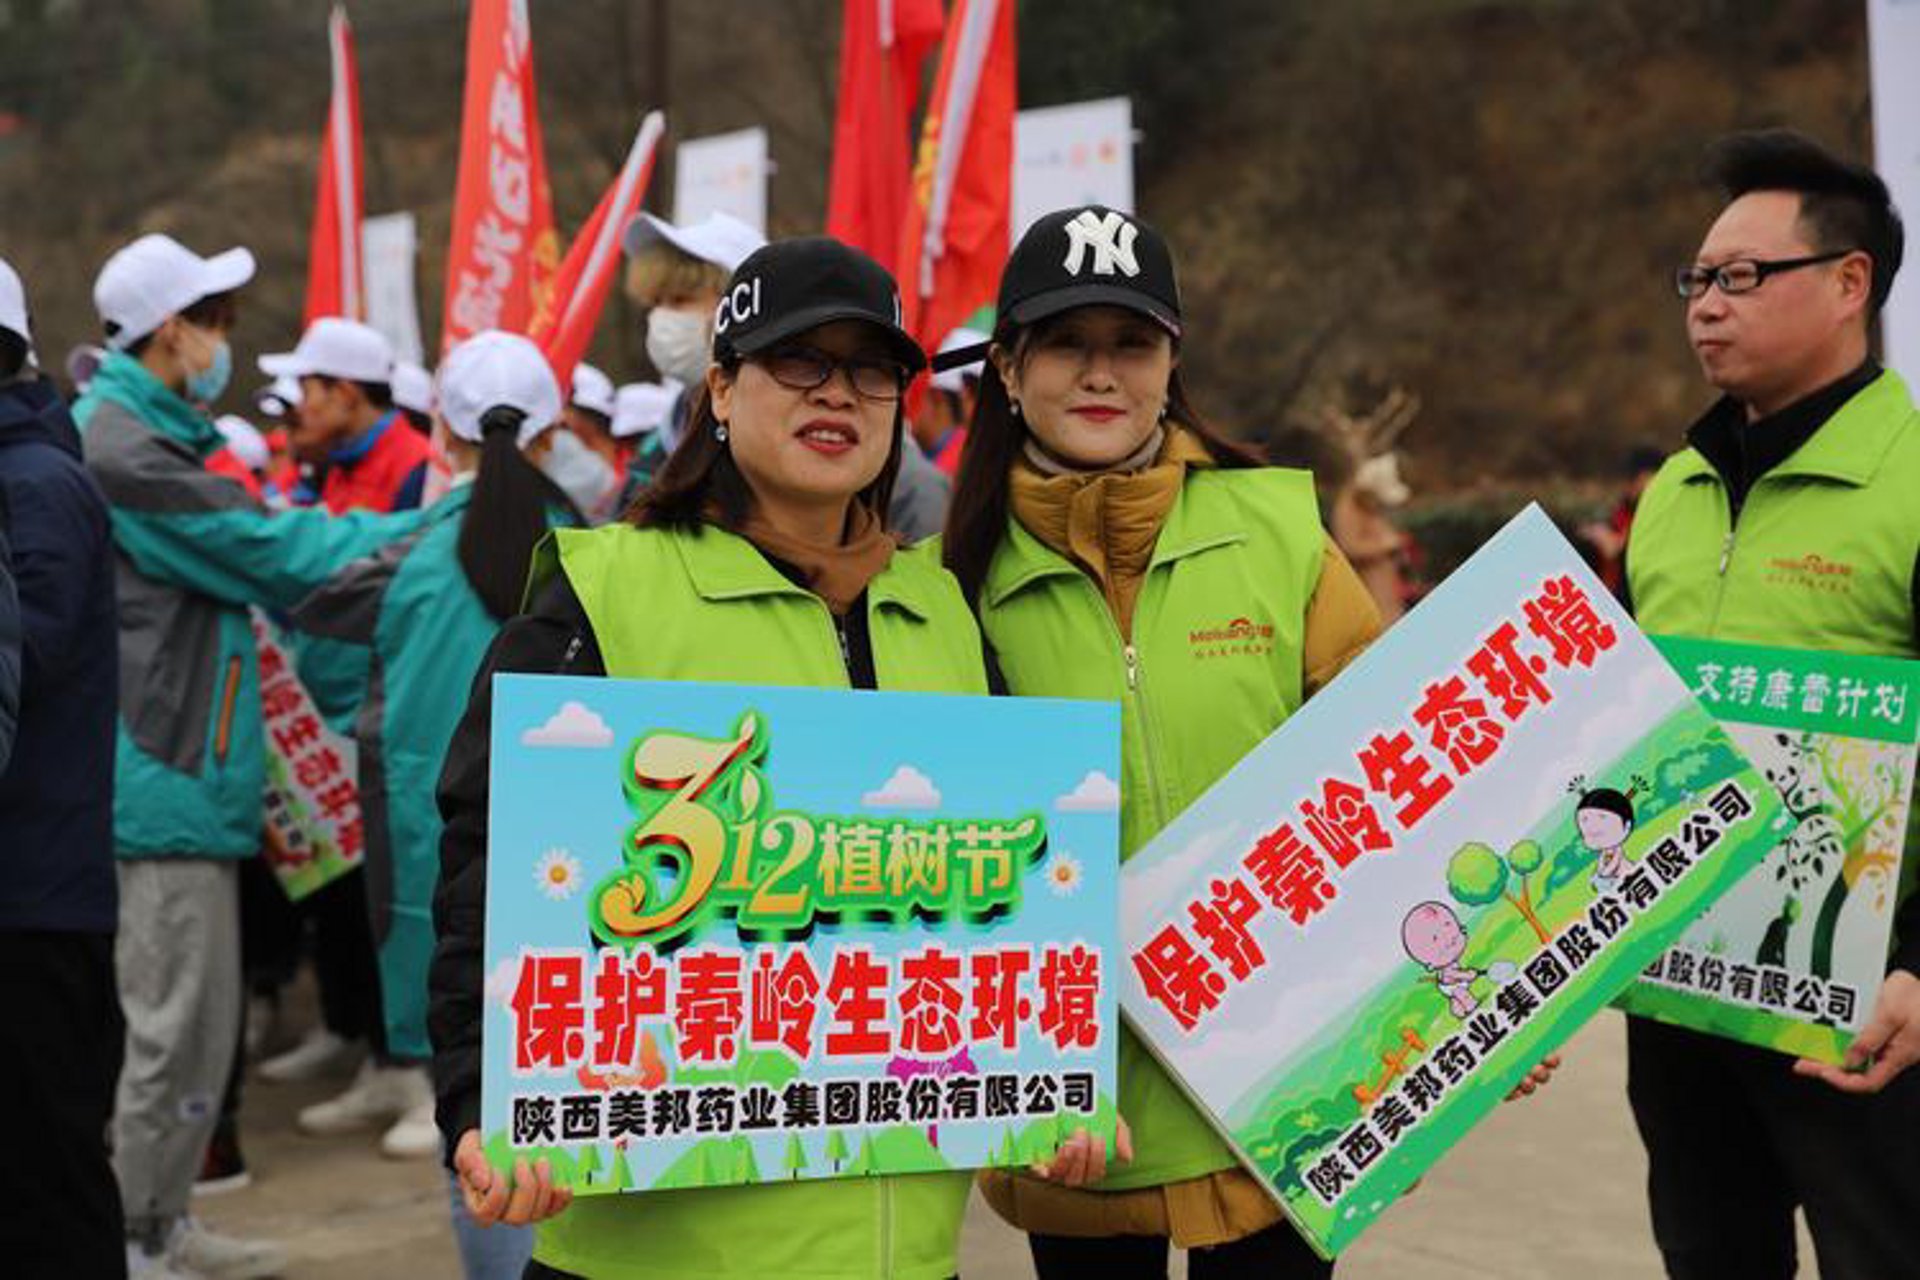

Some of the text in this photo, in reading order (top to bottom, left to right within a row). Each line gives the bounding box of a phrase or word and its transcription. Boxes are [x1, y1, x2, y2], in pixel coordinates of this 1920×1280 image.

[1063, 209, 1140, 277] NY
[1130, 575, 1620, 1032] 保护秦岭生态环境
[511, 946, 1099, 1068] 保护秦岭生态环境
[1306, 783, 1752, 1202] 陕西美邦药业集团股份有限公司
[512, 1073, 1096, 1145] 陕西美邦药业集团股份有限公司
